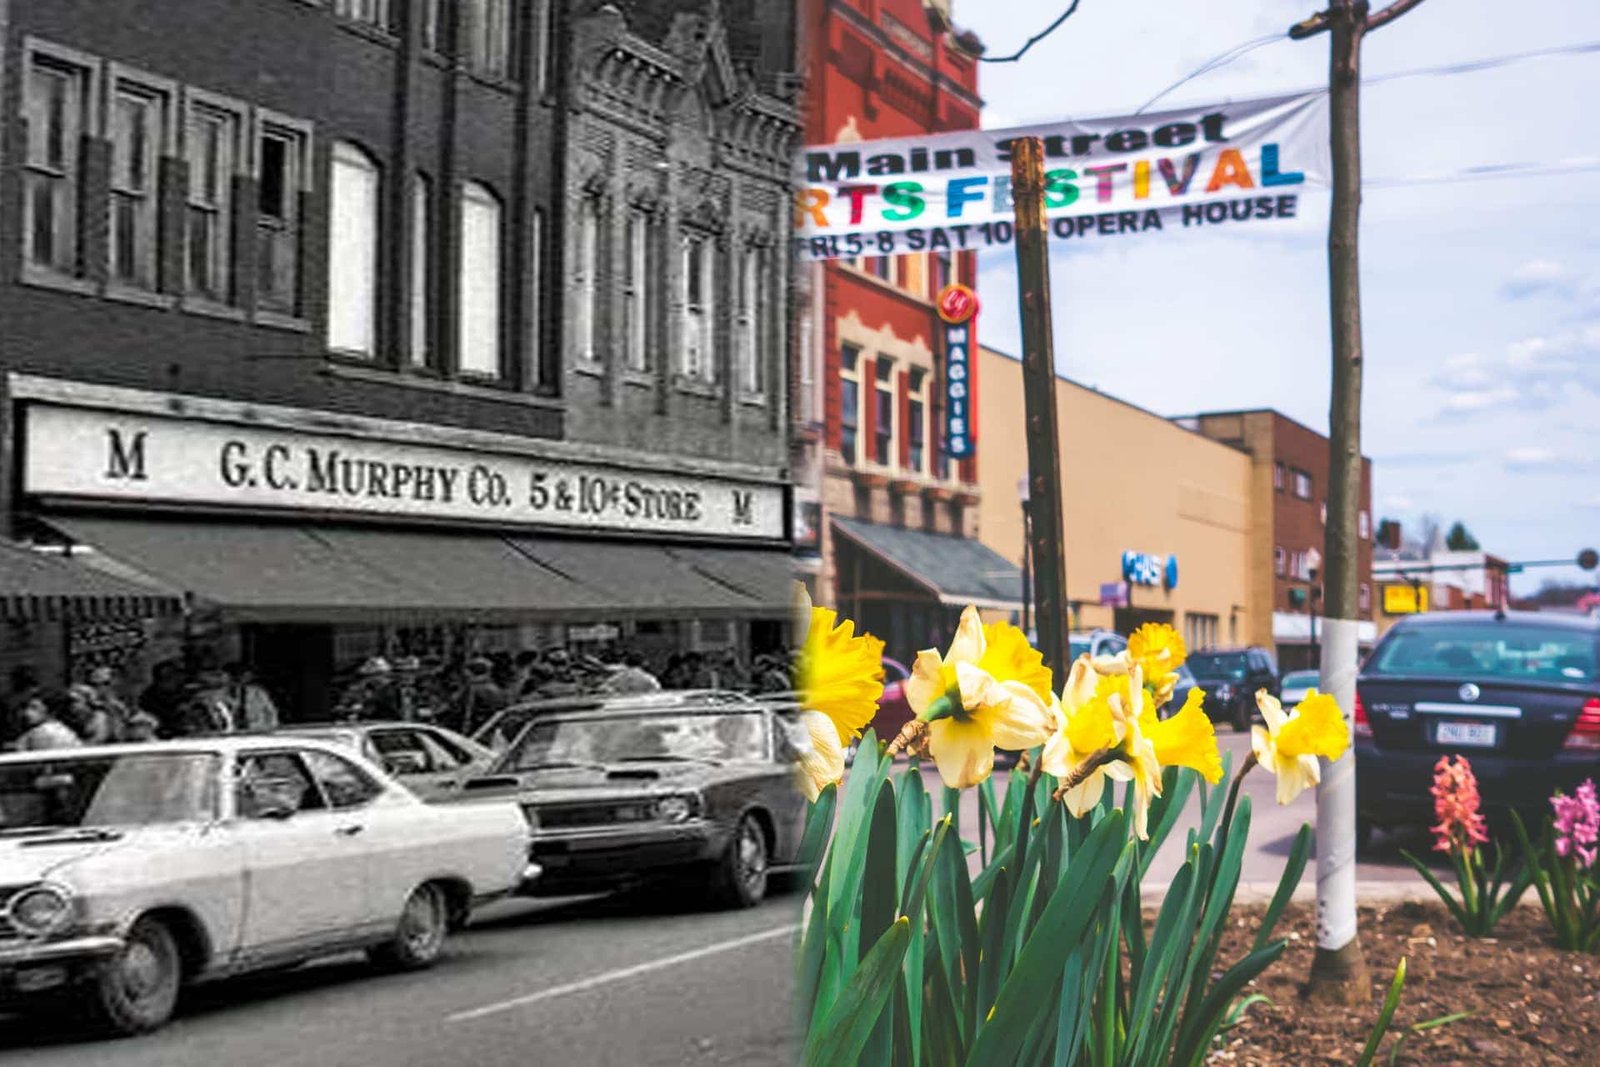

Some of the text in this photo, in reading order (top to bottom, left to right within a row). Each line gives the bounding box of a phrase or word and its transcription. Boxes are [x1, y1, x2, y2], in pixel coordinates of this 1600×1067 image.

[806, 148, 975, 182] Main
[905, 225, 969, 251] SAT
[1054, 208, 1162, 239] OPERA
[1182, 194, 1297, 227] HOUSE
[106, 429, 148, 479] M
[306, 448, 459, 502] MURPHY
[624, 482, 702, 521] STORE
